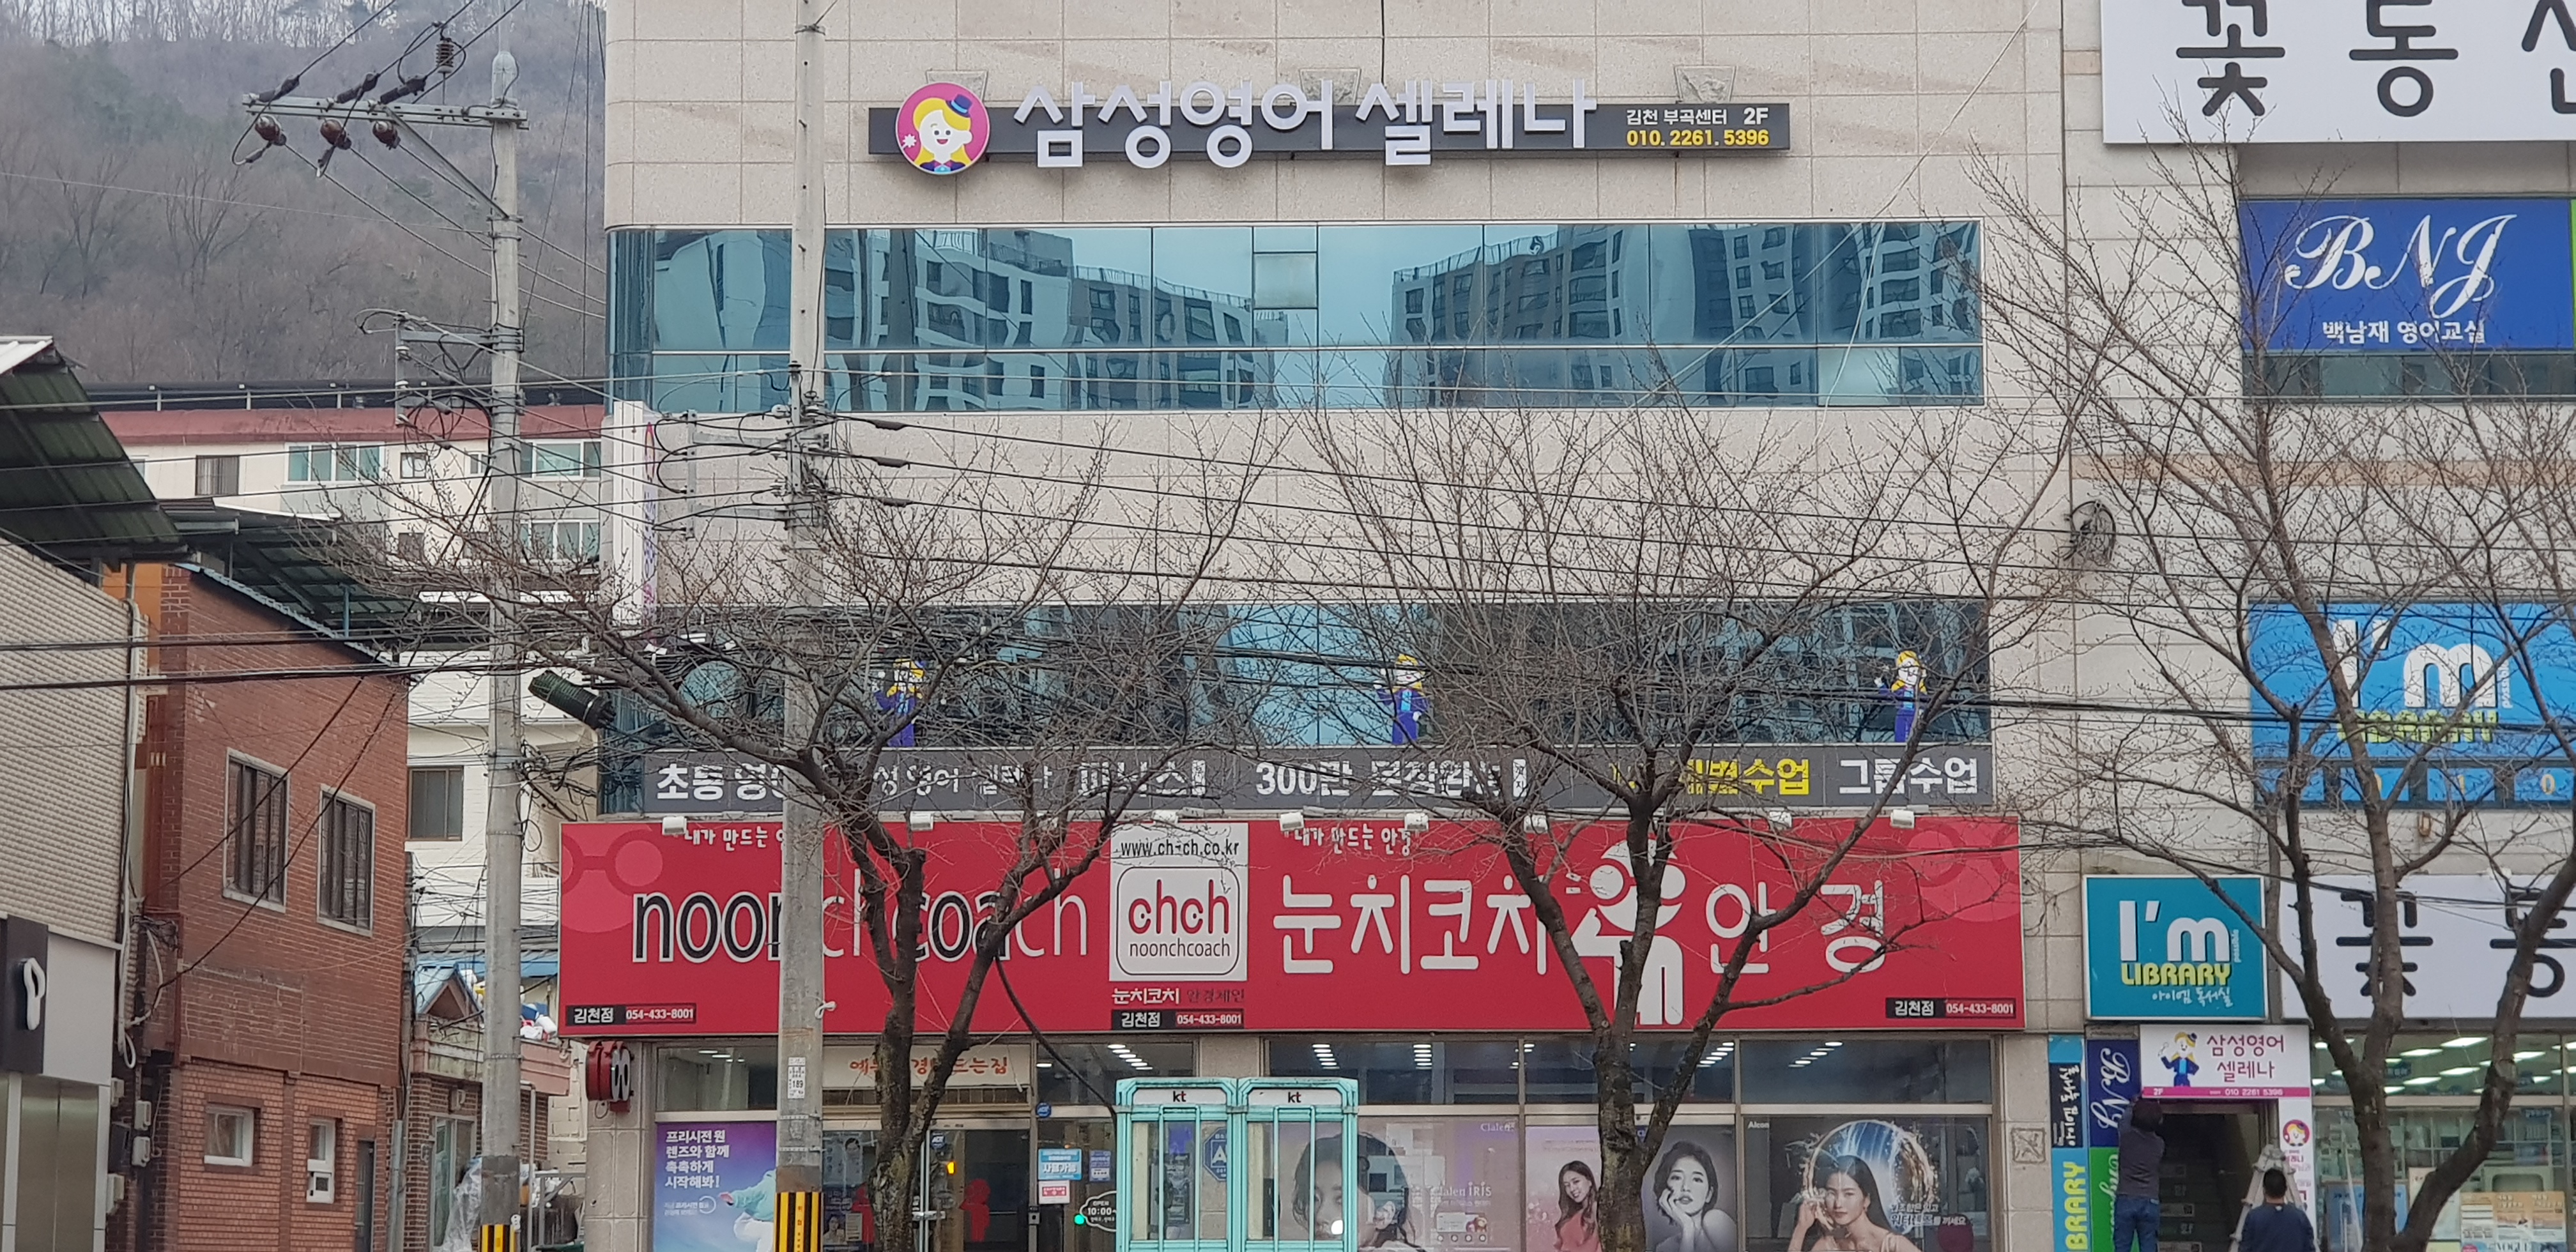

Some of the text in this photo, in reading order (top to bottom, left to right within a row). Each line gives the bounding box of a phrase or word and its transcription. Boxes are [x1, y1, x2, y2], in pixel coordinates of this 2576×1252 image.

[1013, 79, 1597, 169] 삼성영어 셀레나
[1627, 107, 1768, 125] 김천 부곡센터 2F
[2285, 214, 2517, 320] BNJ
[2322, 321, 2389, 344] 백남재
[657, 764, 724, 800] 초등
[1839, 757, 1978, 795] 그룹수업
[723, 825, 769, 852] 만드는
[1331, 823, 1374, 854] 만드는
[1273, 874, 1547, 975] 눈치코치
[2119, 900, 2230, 962] I'm
[1129, 937, 1231, 958] noonchcoach
[2121, 963, 2232, 986] LIBRARY
[1112, 988, 1180, 1005] 눈치코치
[2152, 986, 2234, 1008] 아이엠 독서실
[573, 1007, 694, 1024] 김천점 054-433-8001
[1894, 1000, 2014, 1016] 김천점 054-433-8001
[1121, 1012, 1243, 1028] 김천점 054-433-8001
[2207, 1034, 2285, 1057] 삼성영어
[2217, 1060, 2275, 1083] 셀레나
[1172, 1090, 1187, 1103] kt
[1287, 1091, 1302, 1104] kt
[1747, 1121, 1770, 1129] Alcon
[666, 1129, 726, 1144] 프리시전 원
[666, 1145, 730, 1159] 렌즈와 함께
[666, 1160, 714, 1173] 촉촉하게
